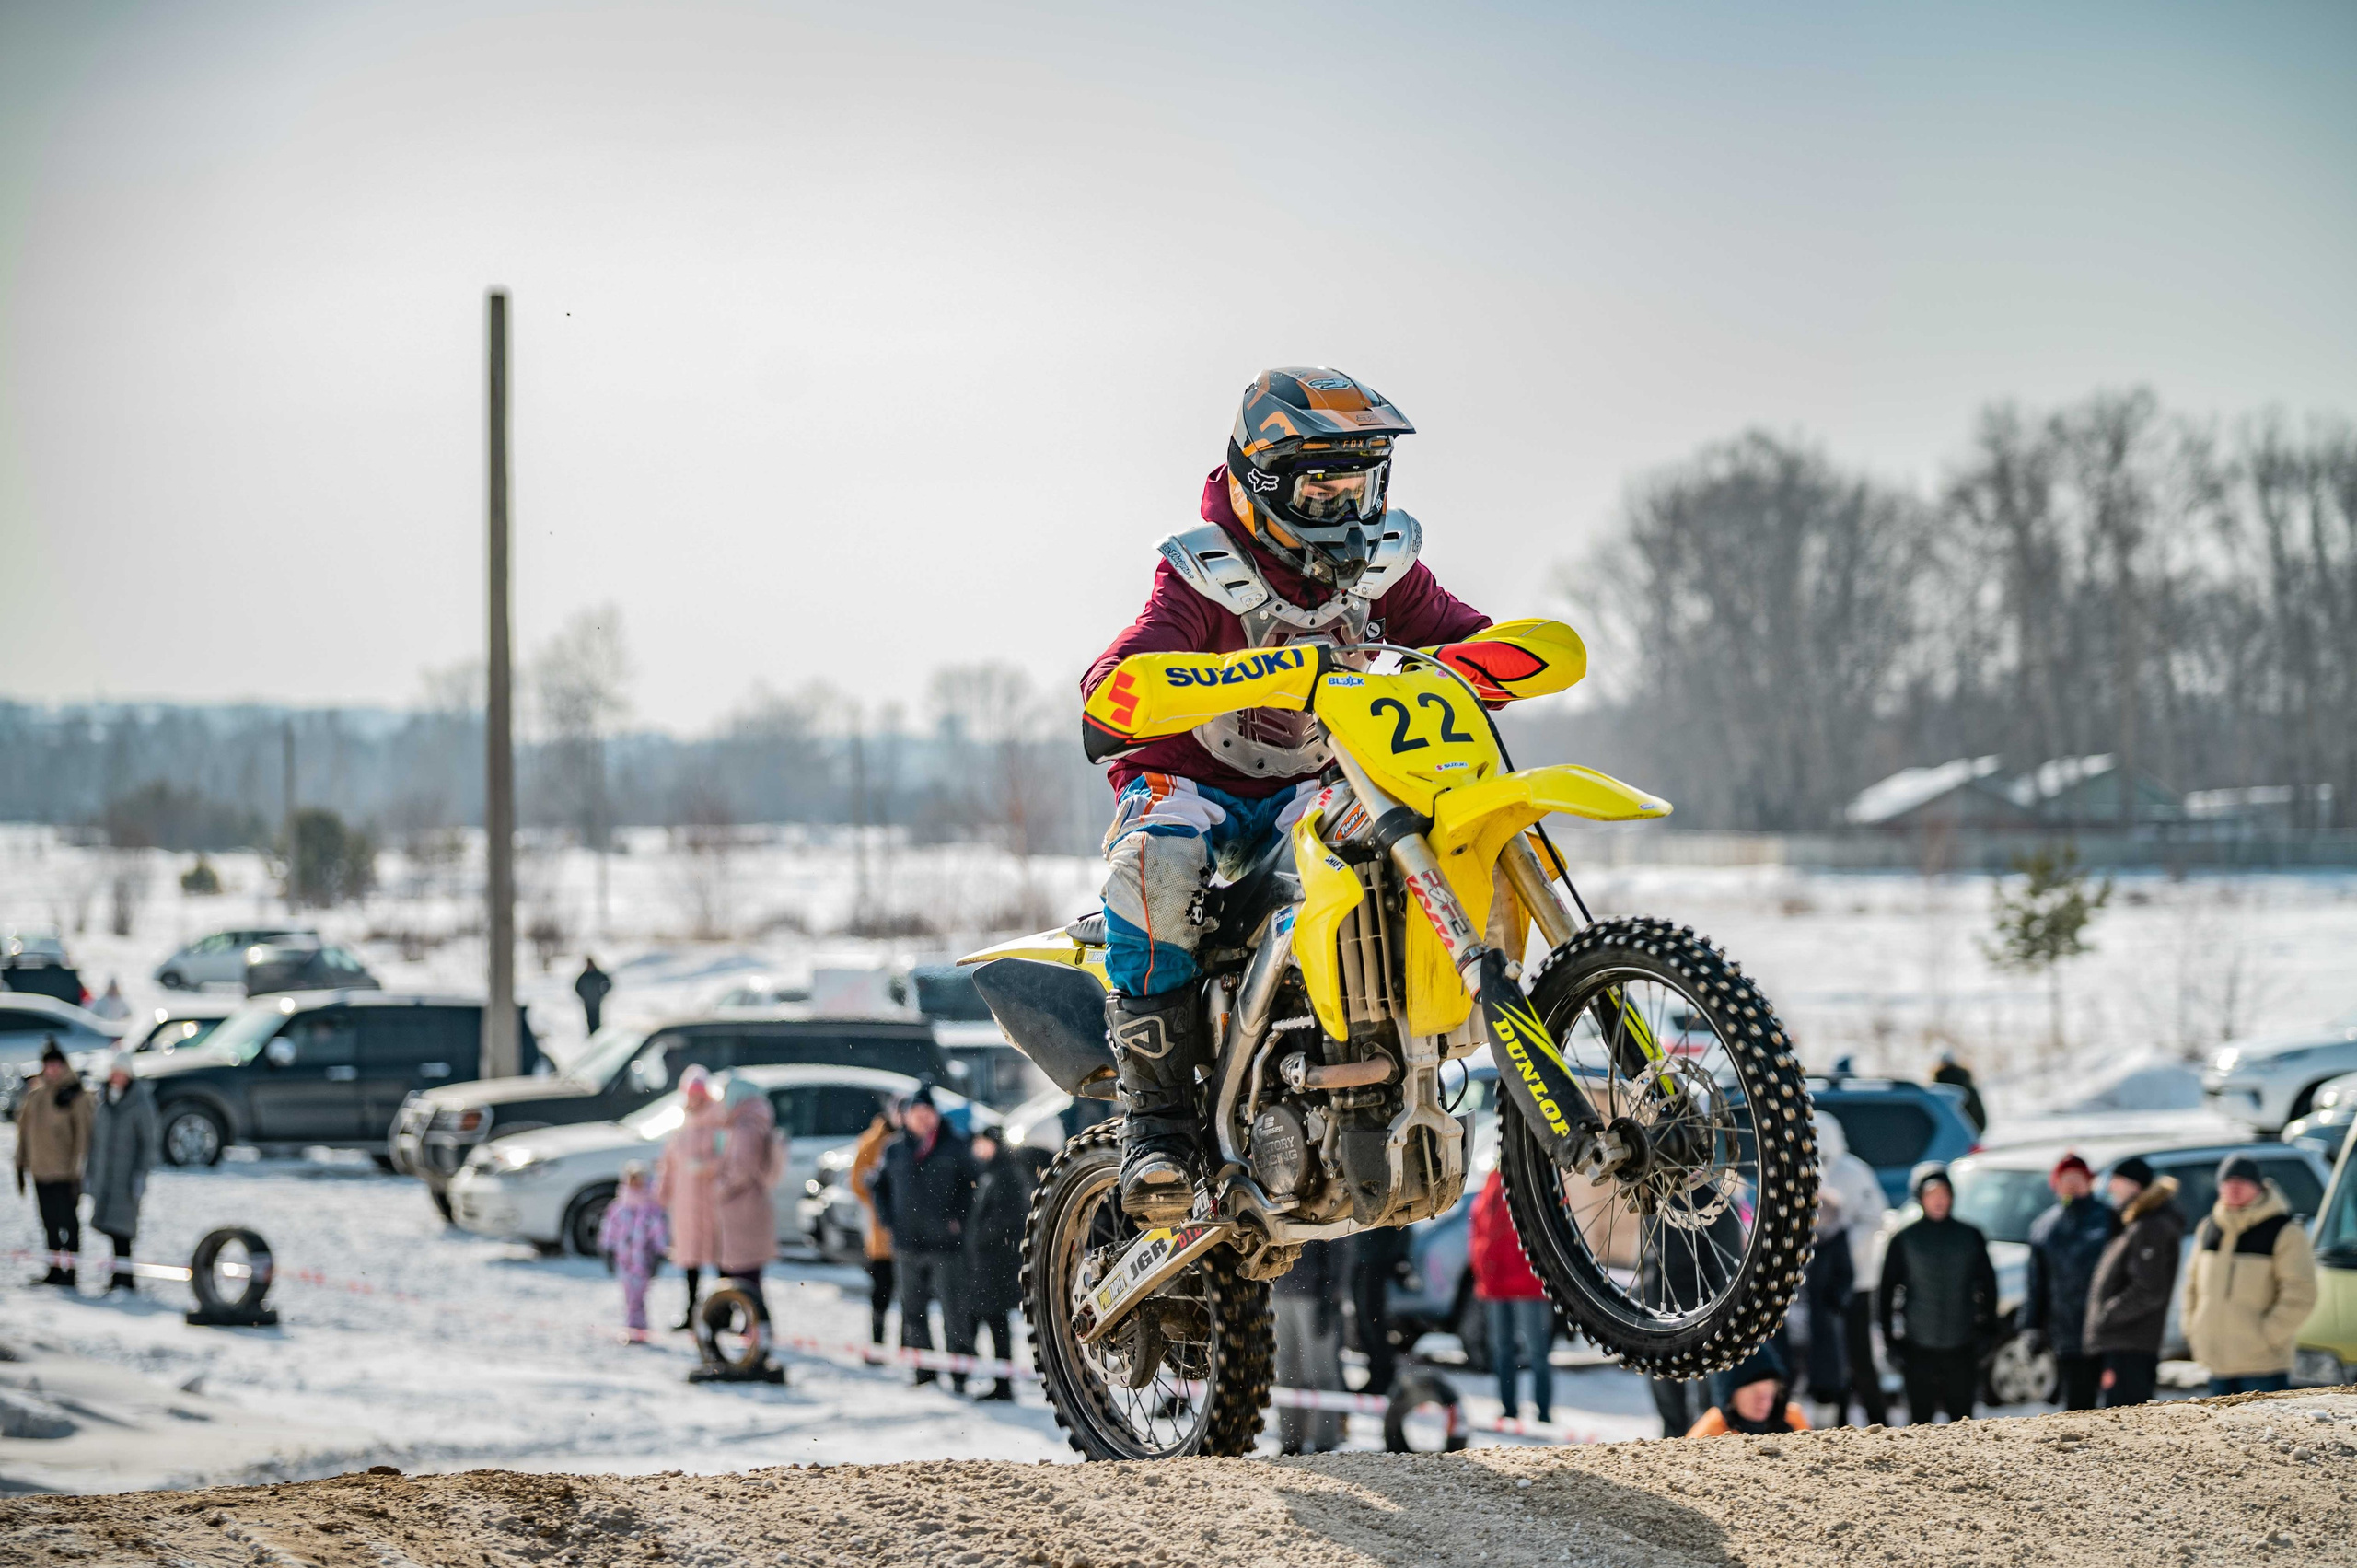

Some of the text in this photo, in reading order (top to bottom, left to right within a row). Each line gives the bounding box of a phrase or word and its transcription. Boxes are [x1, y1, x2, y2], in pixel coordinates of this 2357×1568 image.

[1342, 439, 1364, 448] FOX
[1165, 648, 1305, 687] SUZUKI
[1370, 692, 1475, 755] 22
[1340, 816, 1359, 836] Twin
[1325, 855, 1345, 871] SHIFT
[1492, 1017, 1570, 1137] DUNLOP
[1128, 1237, 1168, 1281] JGR
